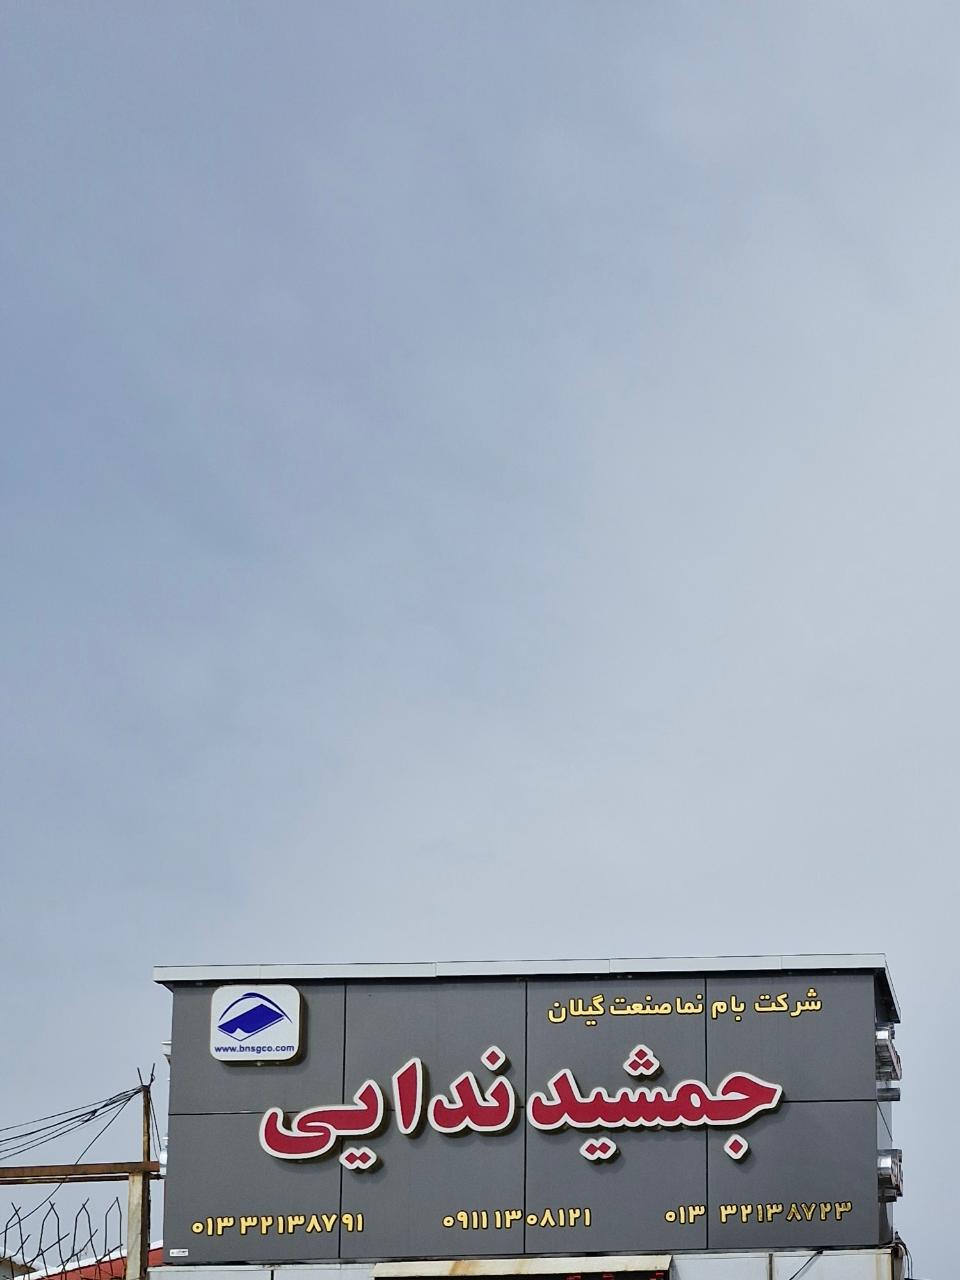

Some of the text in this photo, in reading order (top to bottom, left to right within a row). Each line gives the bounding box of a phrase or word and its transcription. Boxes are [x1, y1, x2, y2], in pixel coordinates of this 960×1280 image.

[547, 994, 605, 1027] گیلان
[710, 995, 746, 1022] بام
[753, 988, 822, 1017] شرکت
[214, 1045, 295, 1054] www.bnsgco.com
[259, 1044, 783, 1169] جمشید ندایی
[664, 1204, 706, 1225] ۰۱۳
